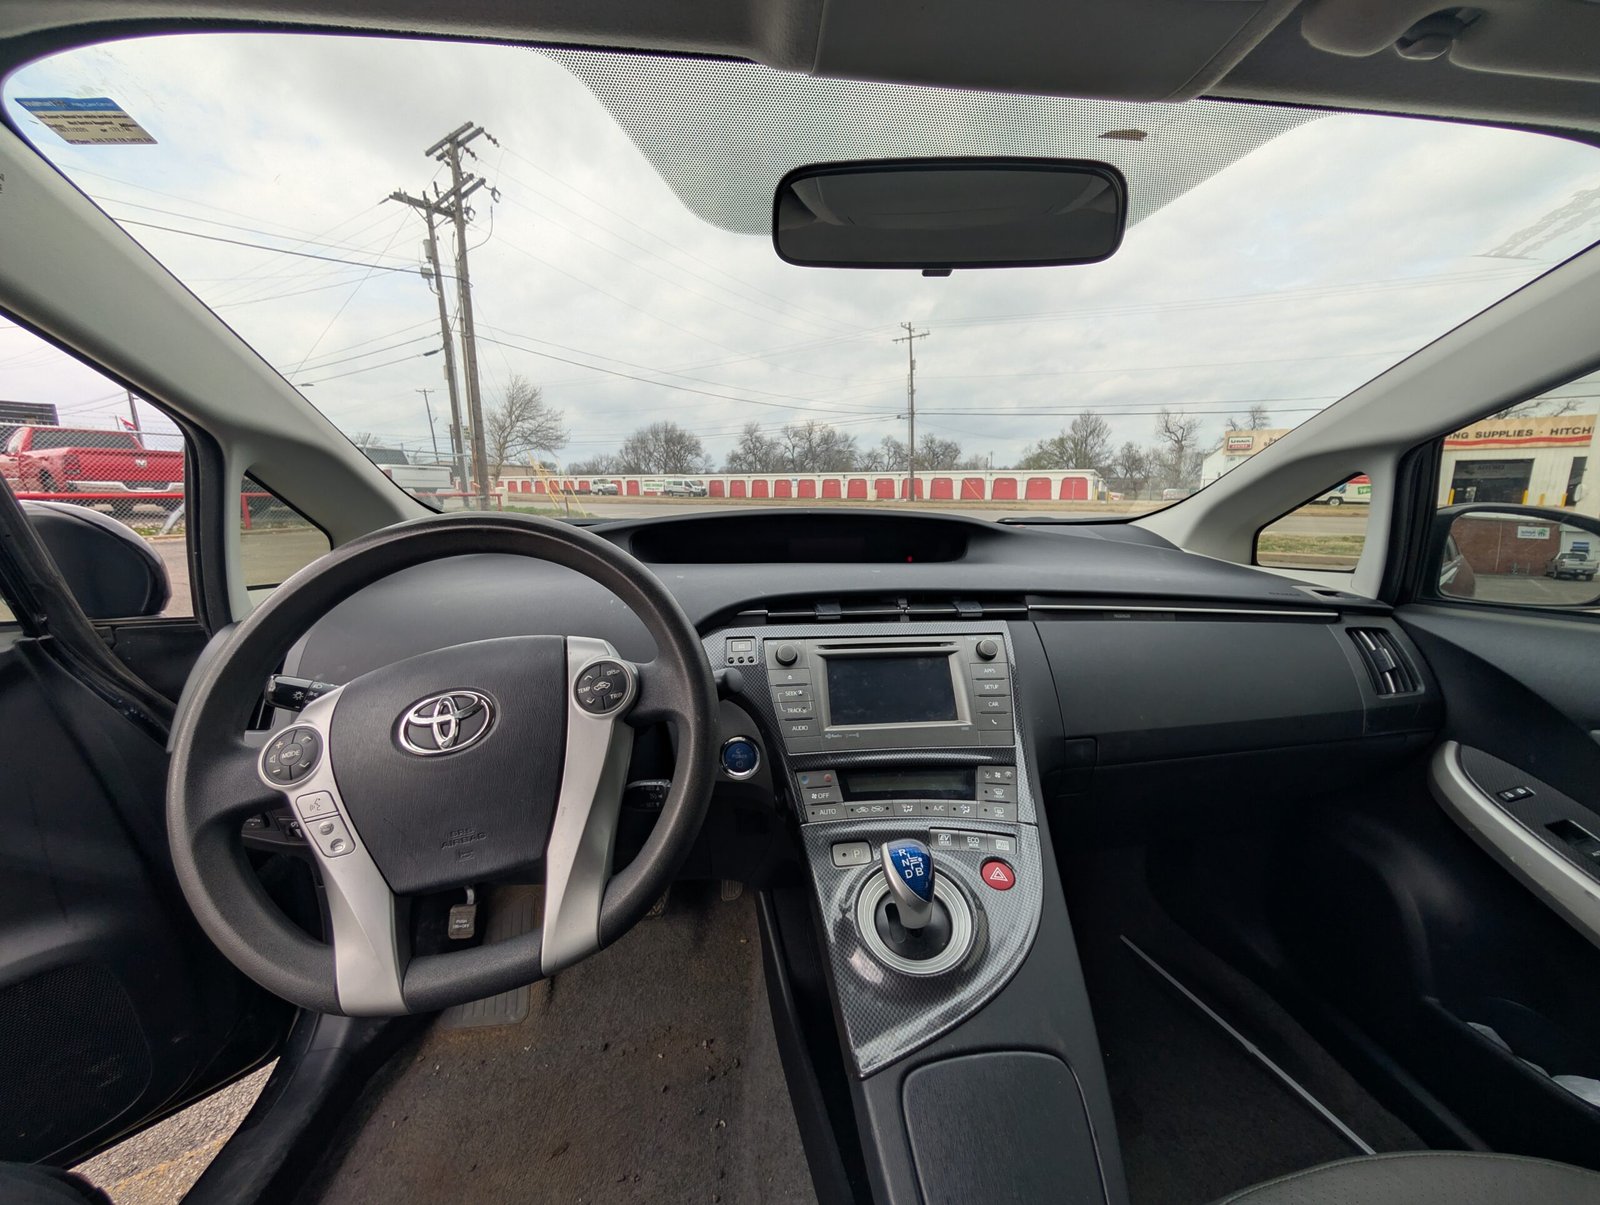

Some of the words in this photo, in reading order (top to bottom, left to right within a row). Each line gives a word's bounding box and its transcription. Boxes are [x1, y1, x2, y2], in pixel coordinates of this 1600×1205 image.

[1475, 429, 1533, 439] SUPPLIES
[578, 686, 591, 694] TEMP
[281, 750, 300, 759] MODE
[819, 808, 837, 816] AUTO
[441, 832, 487, 850] AIRBAG
[967, 836, 980, 844] ECO
[853, 850, 861, 858] P
[898, 848, 907, 857] R
[901, 858, 909, 867] N
[905, 869, 913, 879] D
[915, 867, 924, 876] B
